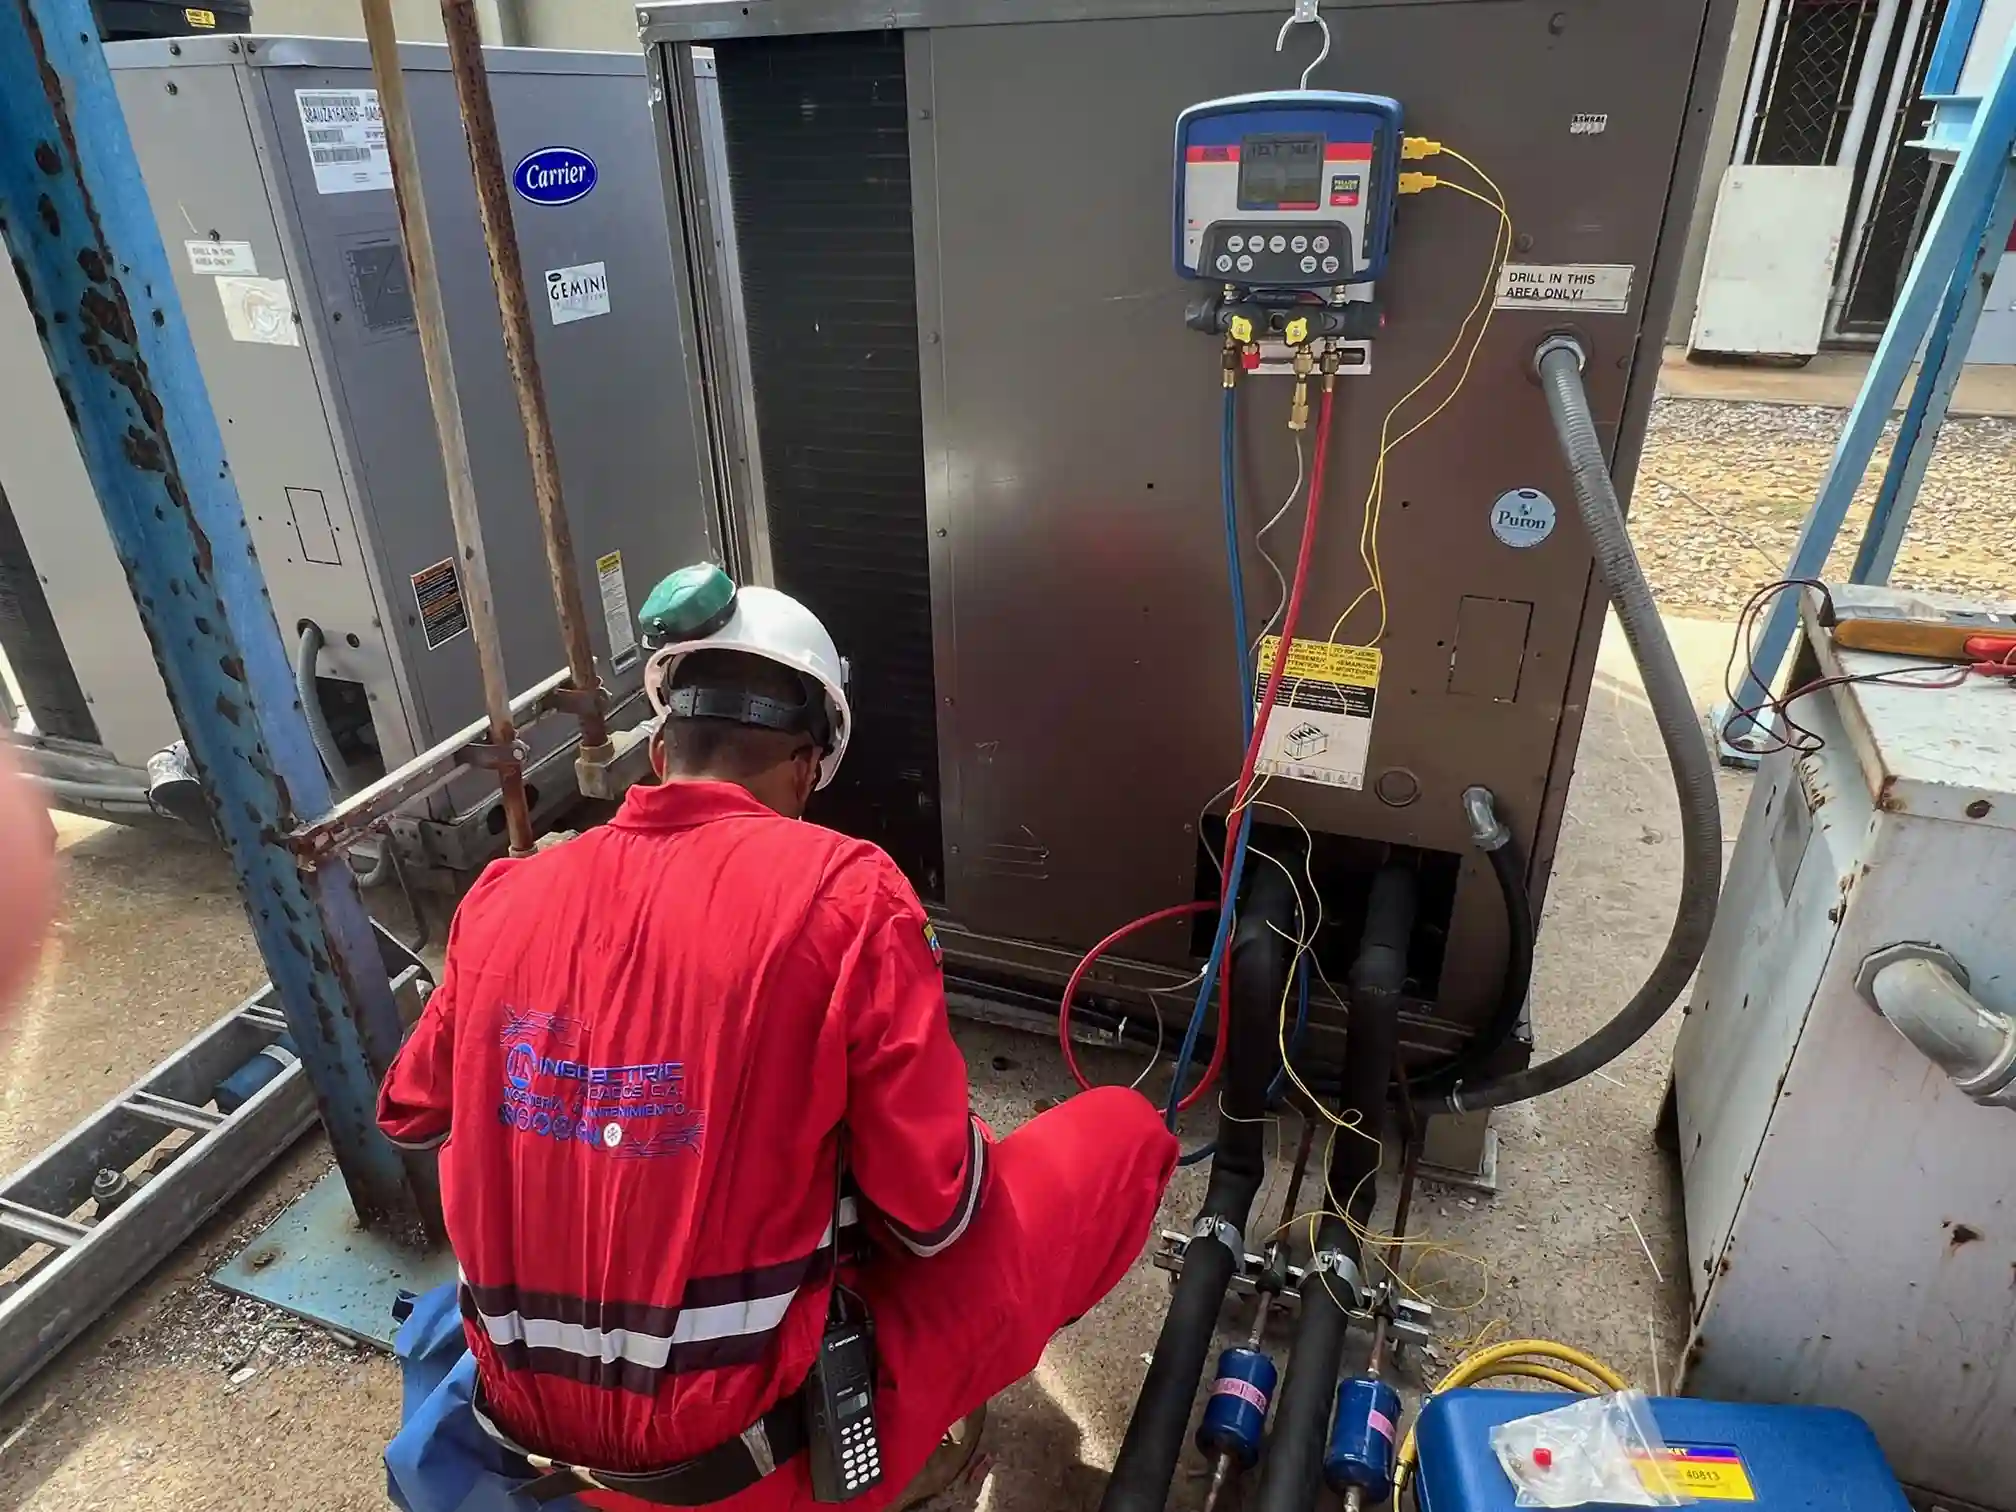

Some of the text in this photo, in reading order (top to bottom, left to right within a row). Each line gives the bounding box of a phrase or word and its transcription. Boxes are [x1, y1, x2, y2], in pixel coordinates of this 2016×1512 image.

[526, 161, 587, 189] Carrier
[1509, 272, 1596, 285] DRILL IN THIS
[550, 275, 606, 301] GEMINI
[1506, 287, 1583, 300] AREA ONLY!
[1497, 510, 1546, 529] Puron
[1686, 1469, 1720, 1481] 40813
